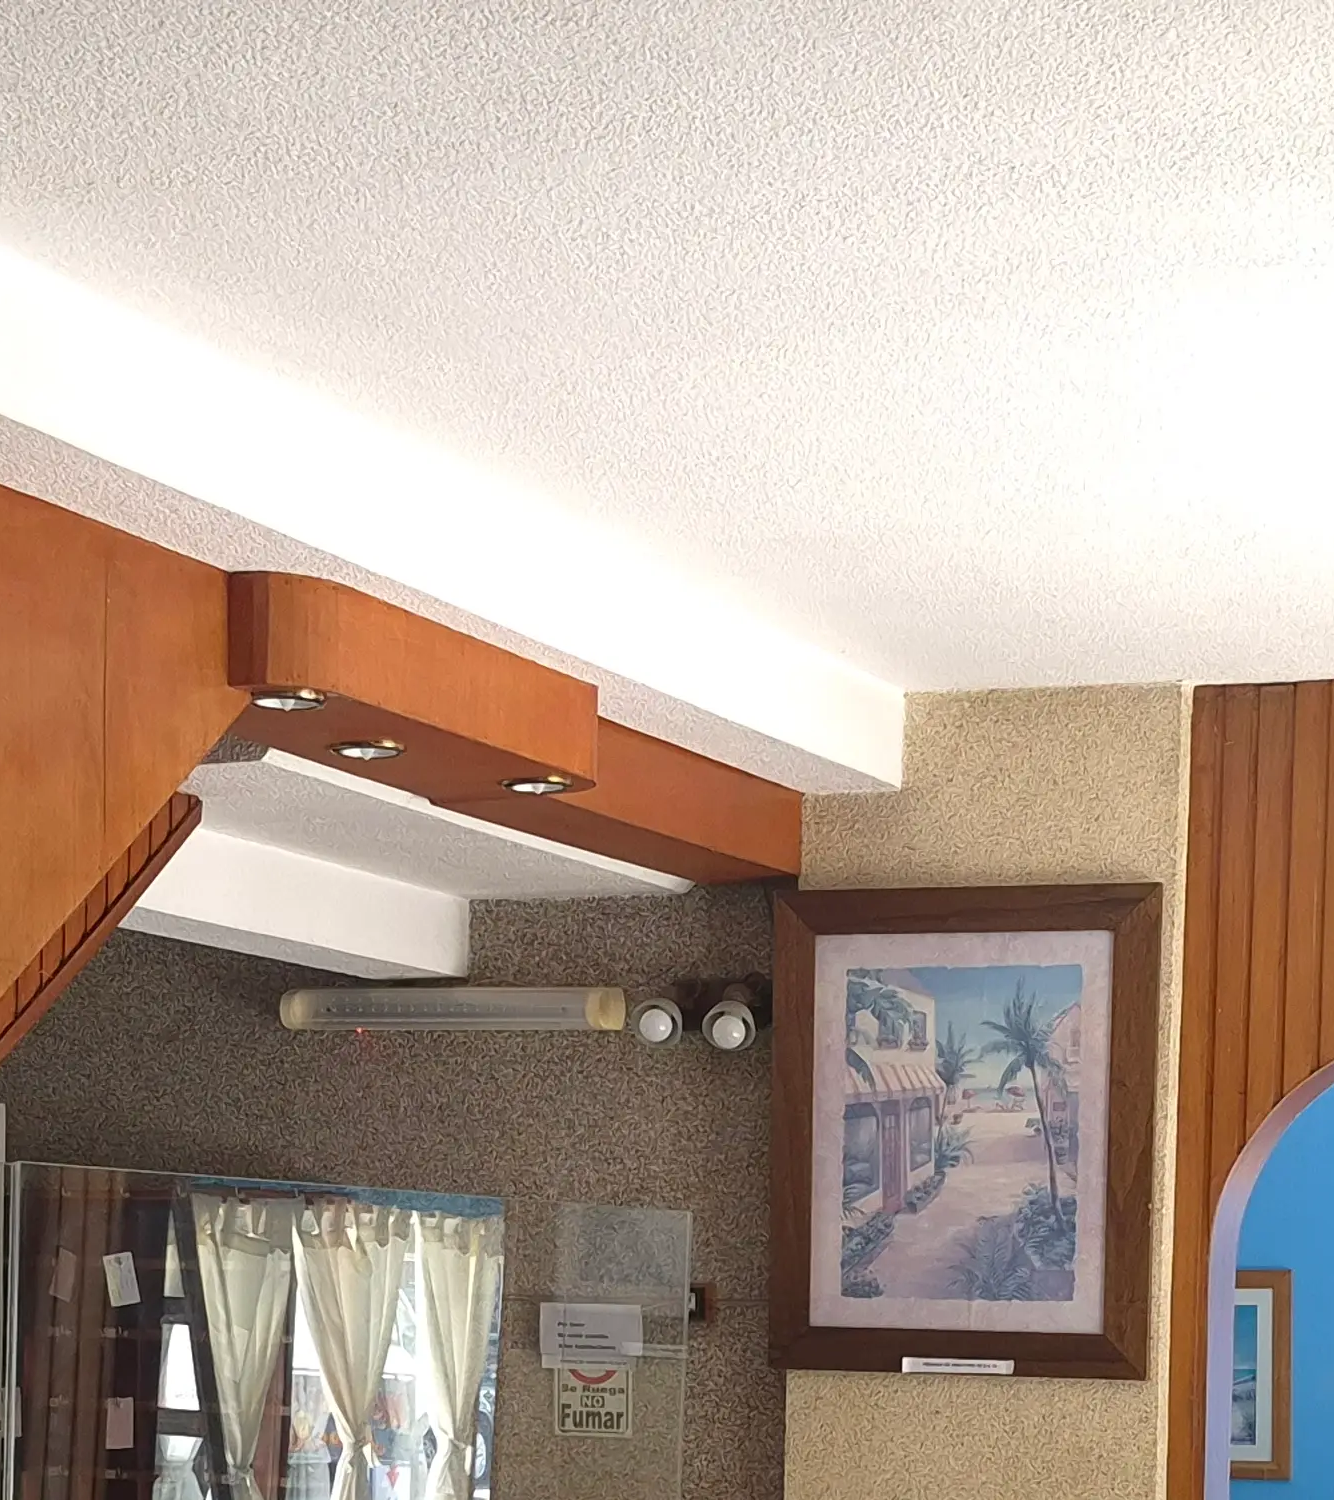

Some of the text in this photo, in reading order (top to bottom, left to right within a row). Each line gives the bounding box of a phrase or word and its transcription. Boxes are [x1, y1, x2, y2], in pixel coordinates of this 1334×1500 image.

[582, 1384, 625, 1396] Ruega
[581, 1395, 604, 1408] NO
[561, 1403, 625, 1430] Fumar
